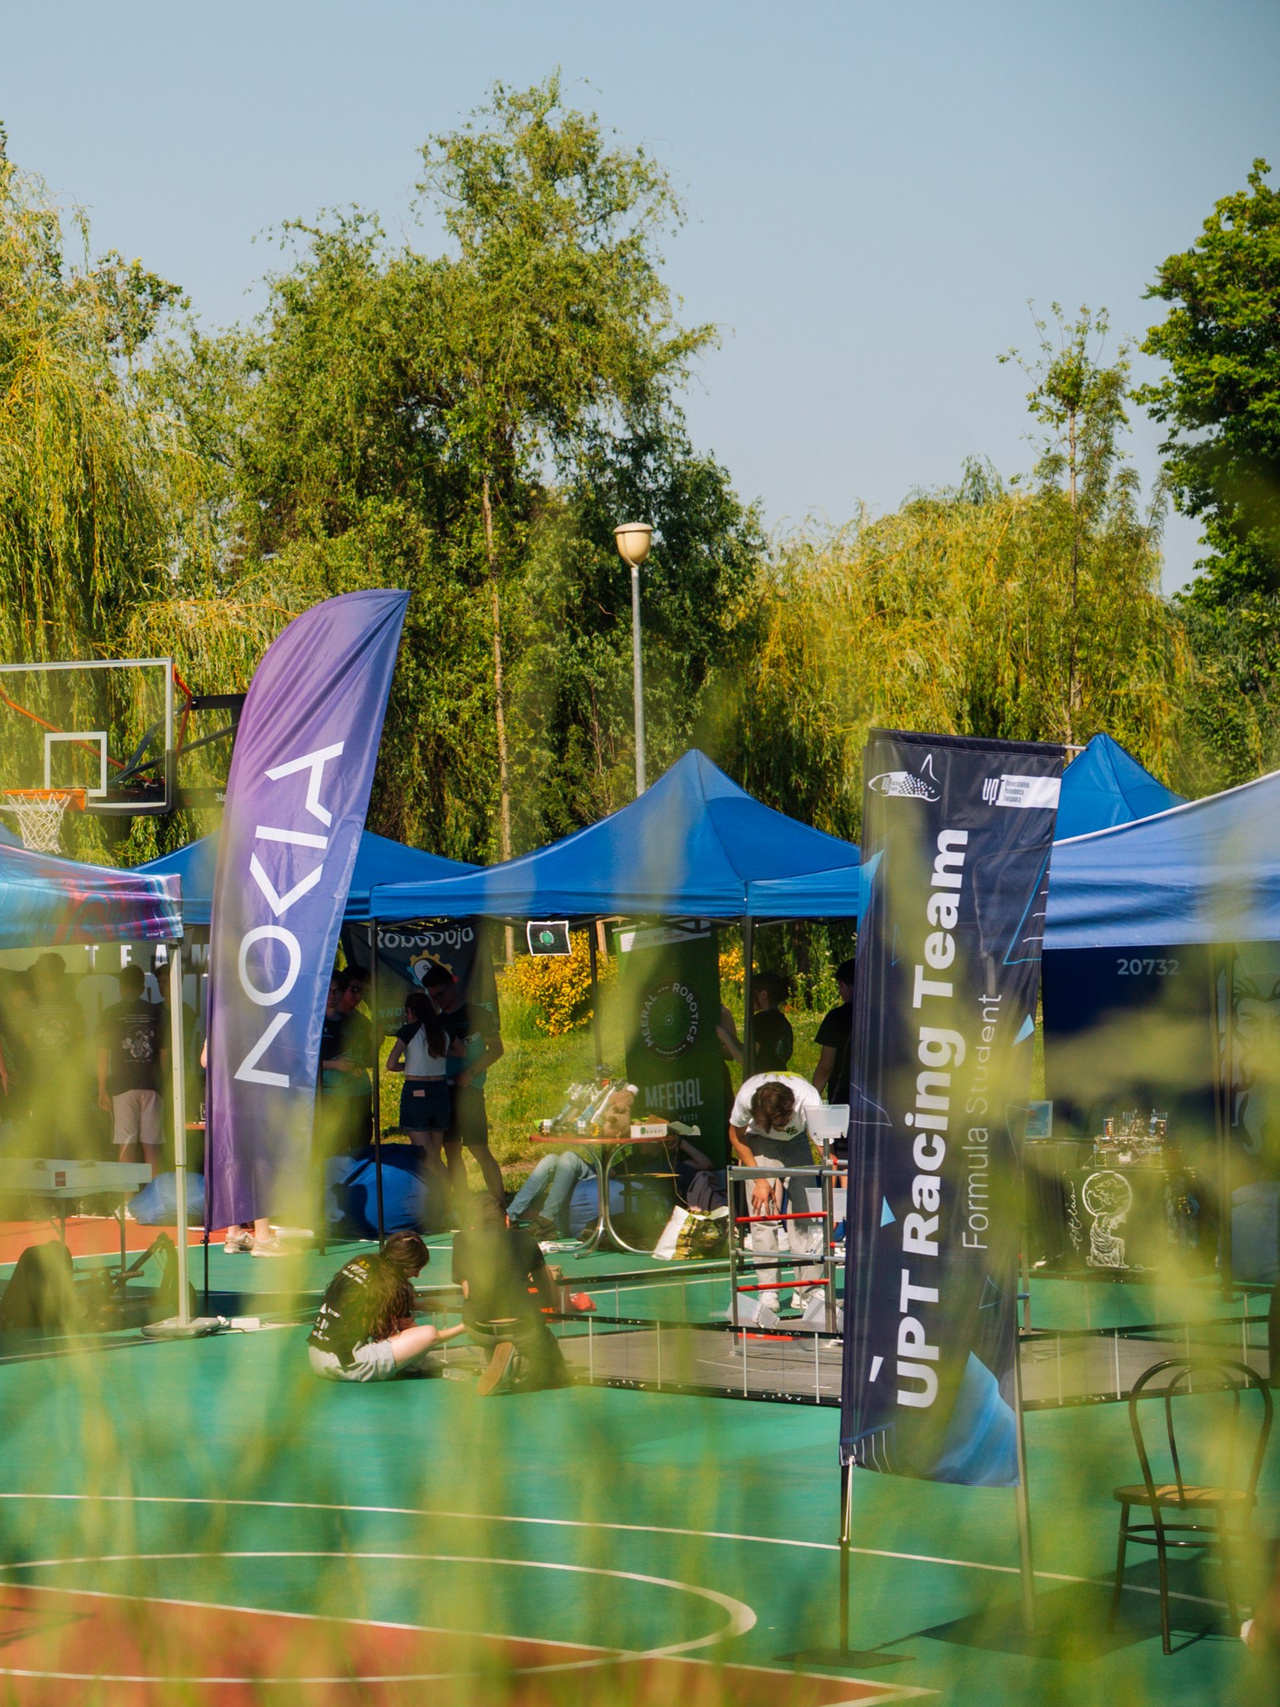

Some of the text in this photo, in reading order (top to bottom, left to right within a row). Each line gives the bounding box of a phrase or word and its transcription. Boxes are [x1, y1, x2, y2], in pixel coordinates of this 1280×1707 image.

[234, 741, 344, 1088] NOKIA
[673, 982, 699, 1043] ROBOTICS
[913, 829, 968, 1008] Team
[1117, 959, 1180, 975] 20732
[903, 1027, 966, 1256] Racing
[962, 994, 1002, 1249] Formula Student
